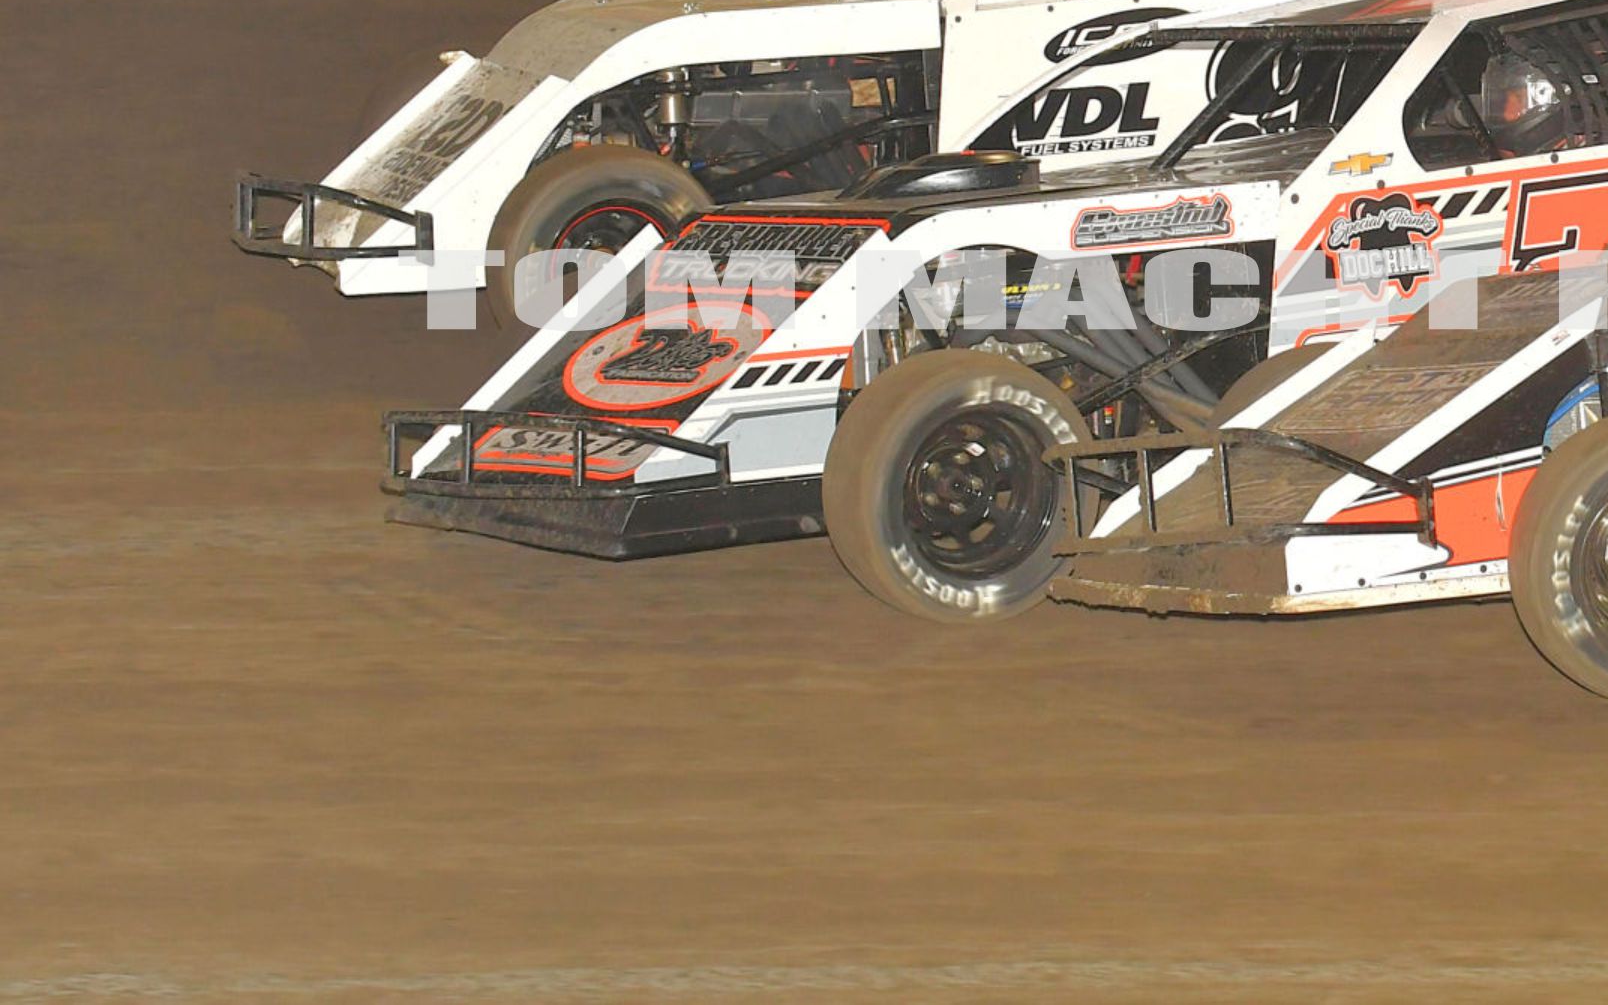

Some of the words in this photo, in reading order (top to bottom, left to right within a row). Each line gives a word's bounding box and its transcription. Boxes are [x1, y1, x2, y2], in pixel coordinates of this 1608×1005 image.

[1020, 141, 1064, 157] FUEL
[1068, 135, 1150, 153] SYSTEMS
[1340, 251, 1386, 282] DOC
[1386, 245, 1433, 276] HILL
